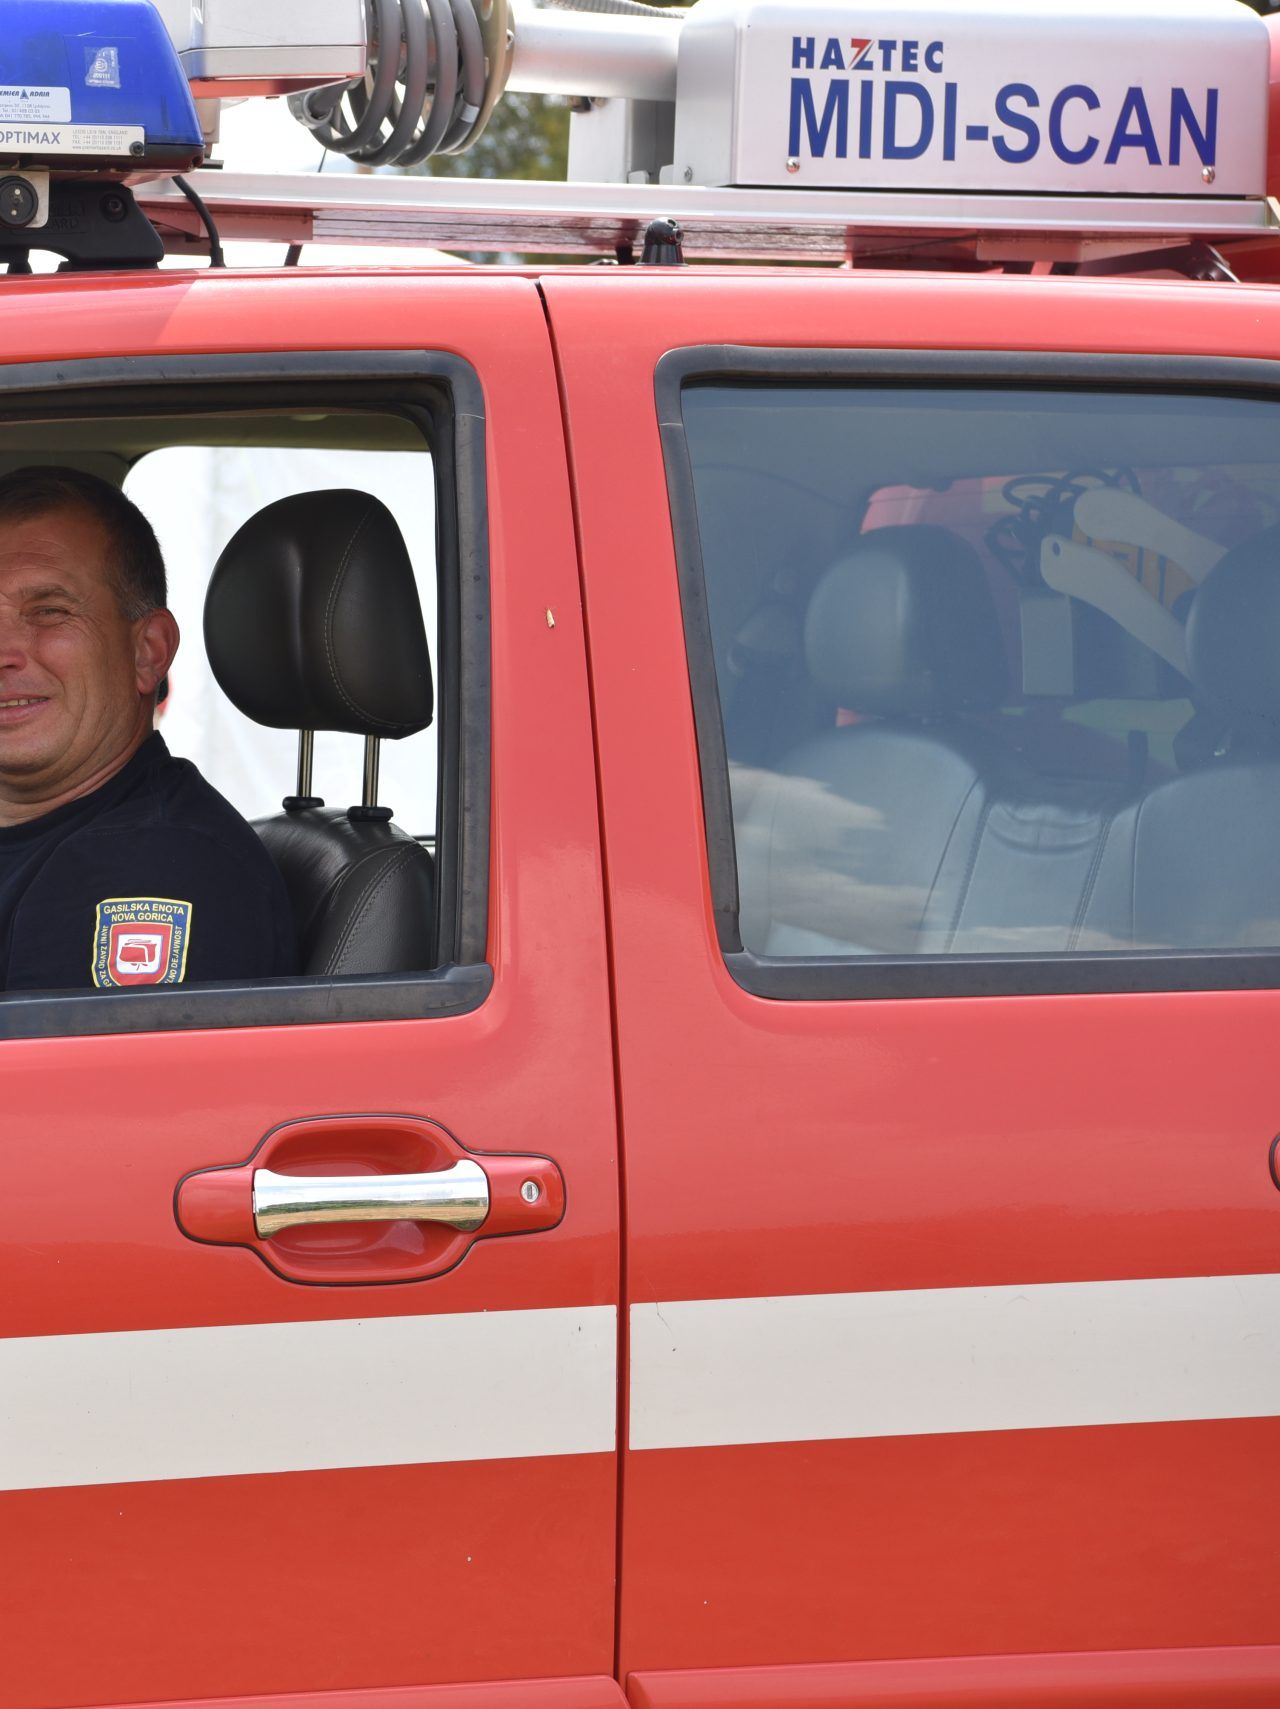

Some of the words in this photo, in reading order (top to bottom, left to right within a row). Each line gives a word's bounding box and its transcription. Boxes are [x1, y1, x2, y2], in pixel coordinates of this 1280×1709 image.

[792, 37, 943, 73] HAZTEC
[788, 77, 1219, 166] MIDI-SCAN
[103, 903, 150, 914] GASILSKA
[152, 903, 184, 915] ENOTA
[111, 912, 136, 922] NOVA
[137, 912, 174, 923] GORICA
[171, 926, 183, 969] DEJAVNOST
